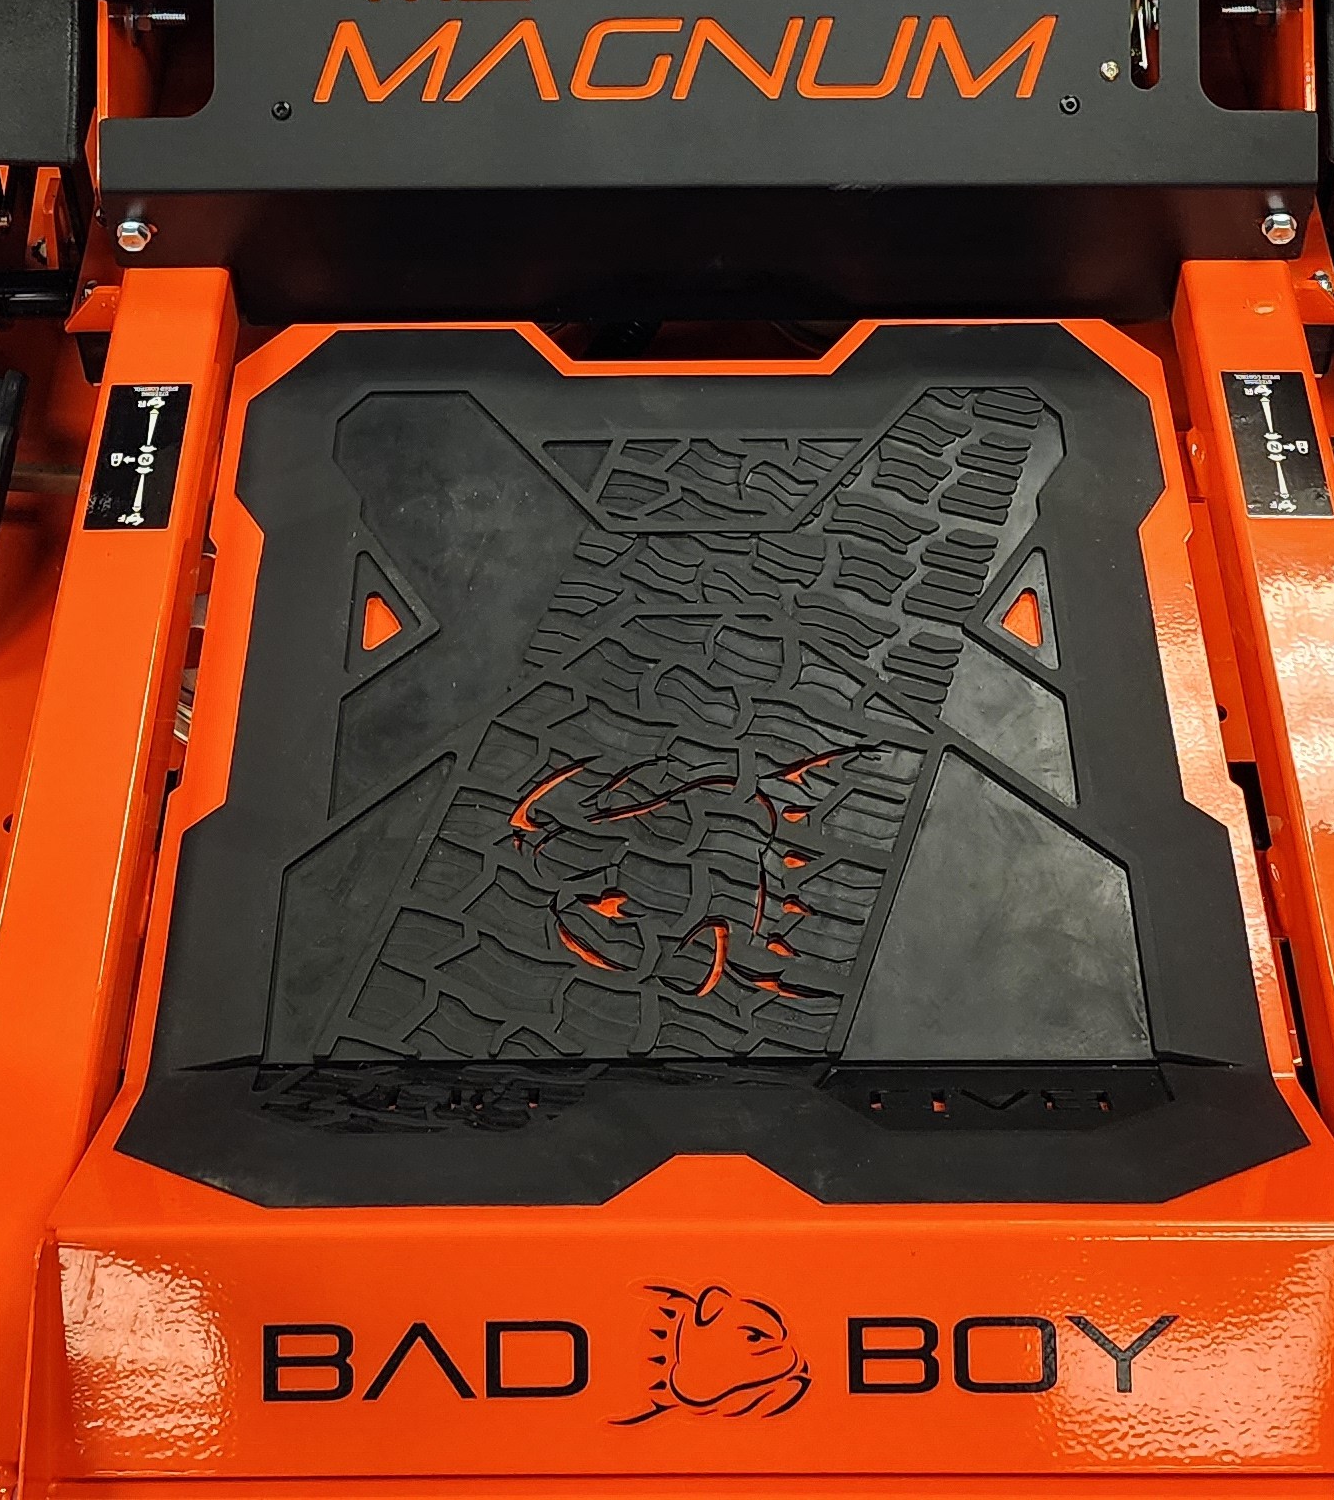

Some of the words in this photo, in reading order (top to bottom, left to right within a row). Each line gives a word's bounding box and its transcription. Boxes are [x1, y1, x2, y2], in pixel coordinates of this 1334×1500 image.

[312, 14, 1059, 103] MAGNUM
[262, 1319, 589, 1402] BAD
[847, 1315, 1180, 1394] BOY
